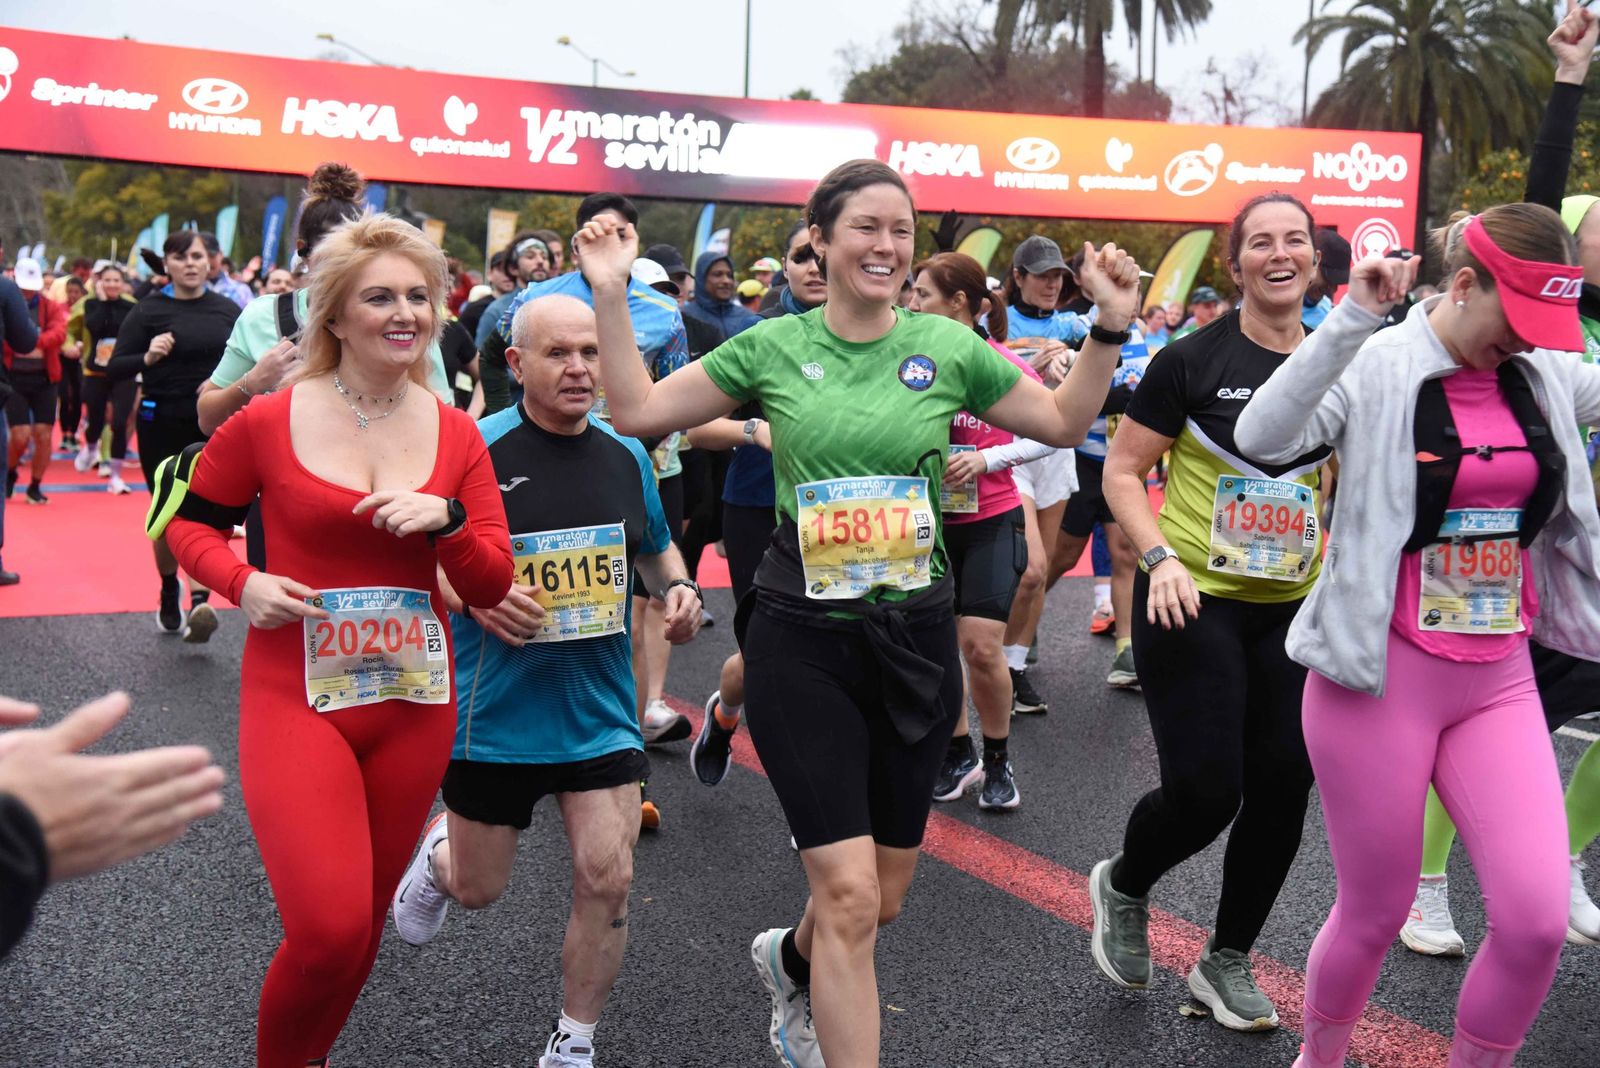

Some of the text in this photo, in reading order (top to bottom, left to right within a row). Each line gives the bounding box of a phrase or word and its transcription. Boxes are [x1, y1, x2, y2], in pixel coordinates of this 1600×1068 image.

[31, 78, 158, 110] Sprinter
[168, 112, 262, 136] HYUNDAI
[281, 97, 401, 142] HOKA
[566, 111, 721, 147] maratón
[604, 141, 724, 174] sevilla
[888, 140, 982, 177] HOKA
[811, 507, 910, 546] 15817
[1224, 500, 1304, 536] 19394
[856, 545, 875, 554] Tanja
[522, 554, 611, 592] 16115
[350, 590, 396, 600] maratón
[363, 599, 398, 608] sevilla
[577, 590, 591, 598] 1993
[316, 616, 426, 657] 20204
[357, 689, 377, 699] HOKA
